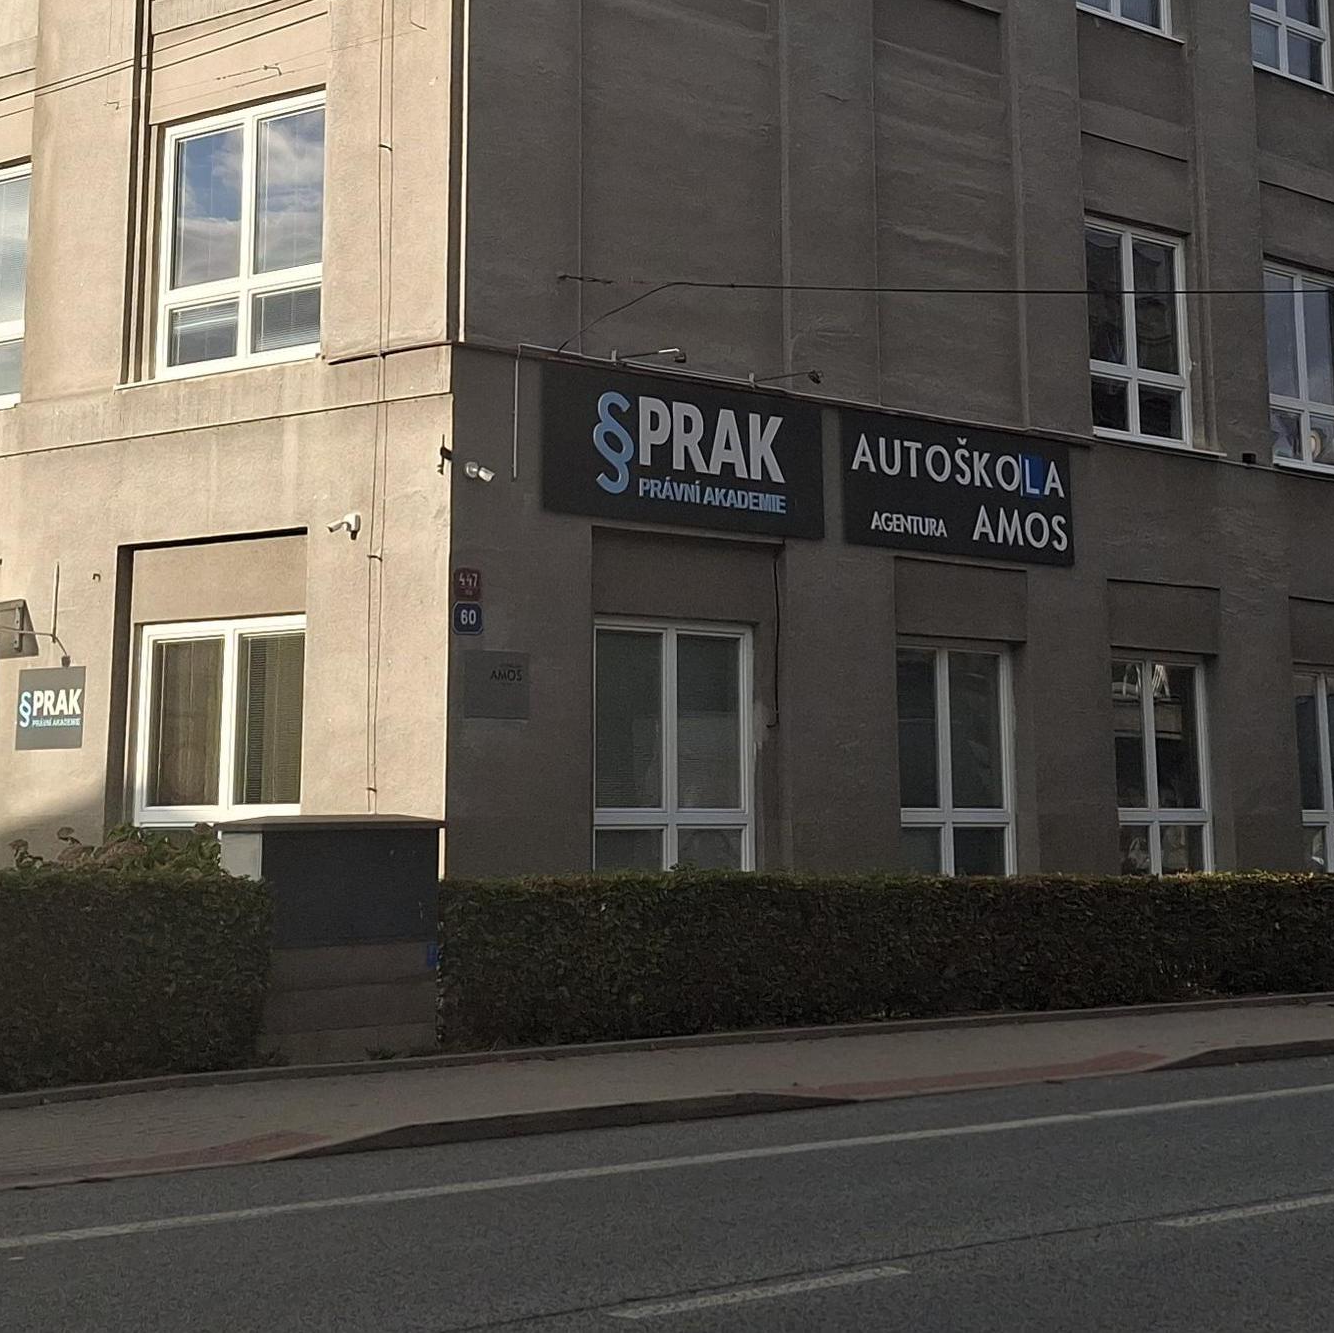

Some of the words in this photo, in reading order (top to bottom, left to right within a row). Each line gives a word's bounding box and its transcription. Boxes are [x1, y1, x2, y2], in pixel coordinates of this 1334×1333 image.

[851, 432, 1065, 498] AUTOŠKOLA
[638, 476, 700, 503] PRÁVNÍ
[703, 487, 786, 514] AKADEMIE
[870, 510, 948, 537] AGENTURA
[972, 504, 1068, 552] AMOS
[490, 669, 523, 682] AMOS
